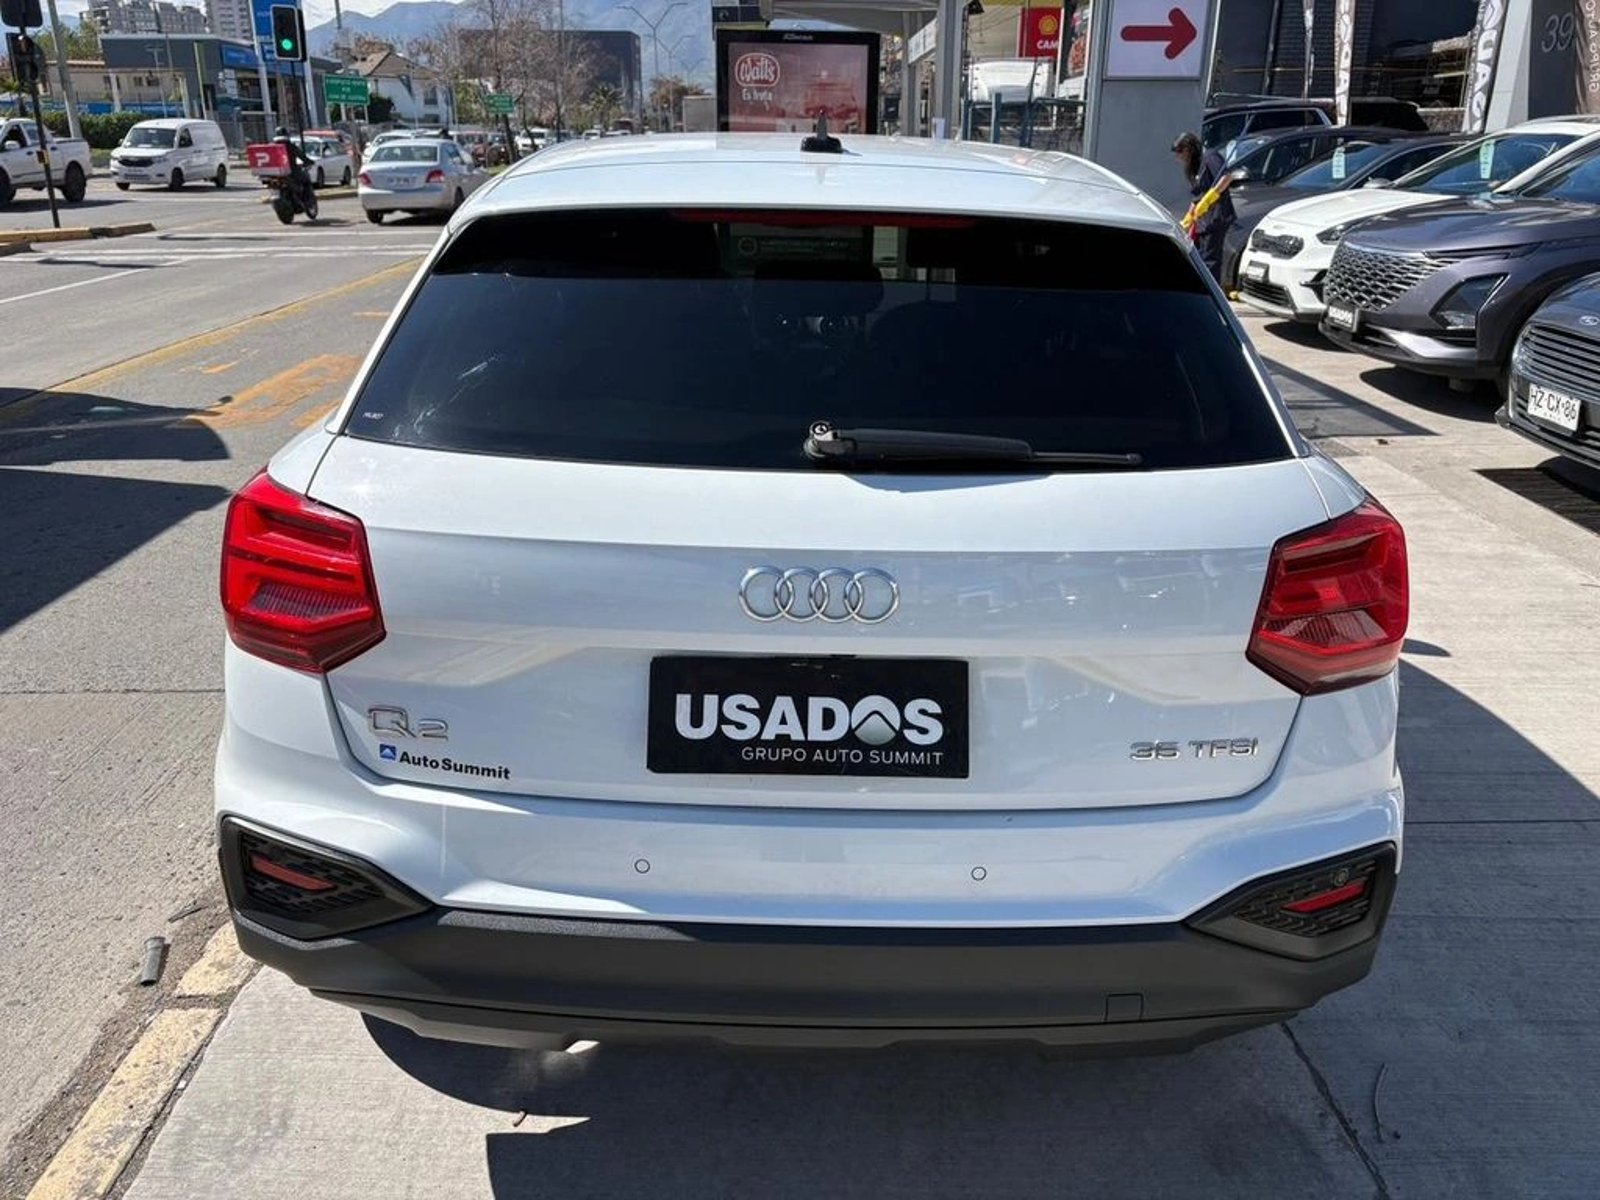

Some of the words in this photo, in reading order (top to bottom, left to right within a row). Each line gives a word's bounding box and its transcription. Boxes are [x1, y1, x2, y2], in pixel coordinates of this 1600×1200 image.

[1541, 12, 1575, 53] 39
[367, 704, 449, 742] Q2
[674, 693, 944, 747] USADOS
[741, 747, 807, 762] GRUPO
[812, 749, 863, 764] AUTO
[869, 750, 944, 766] SUMMIT
[1129, 740, 1181, 762] 35
[1187, 736, 1260, 759] TFSI
